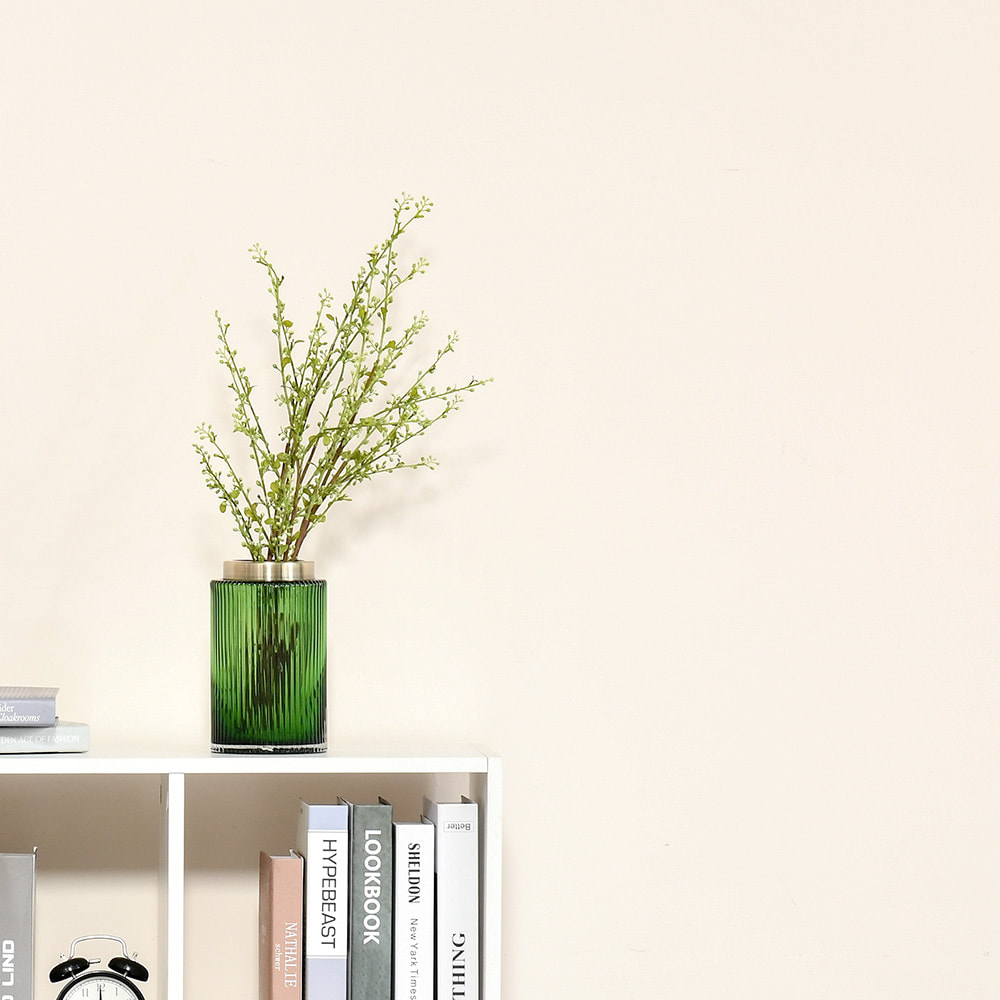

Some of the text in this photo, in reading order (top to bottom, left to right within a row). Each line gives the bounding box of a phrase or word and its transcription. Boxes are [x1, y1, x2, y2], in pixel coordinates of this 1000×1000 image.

[320, 839, 337, 949] HYPEBEAST
[363, 830, 382, 945] LOOKBOOK
[407, 843, 420, 904] SHELDON
[410, 918, 419, 940] New
[2, 939, 15, 987] LIND
[284, 922, 298, 988] NATHALIE
[82, 988, 89, 997] 11
[97, 983, 106, 992] 12
[410, 969, 419, 1000] Times
